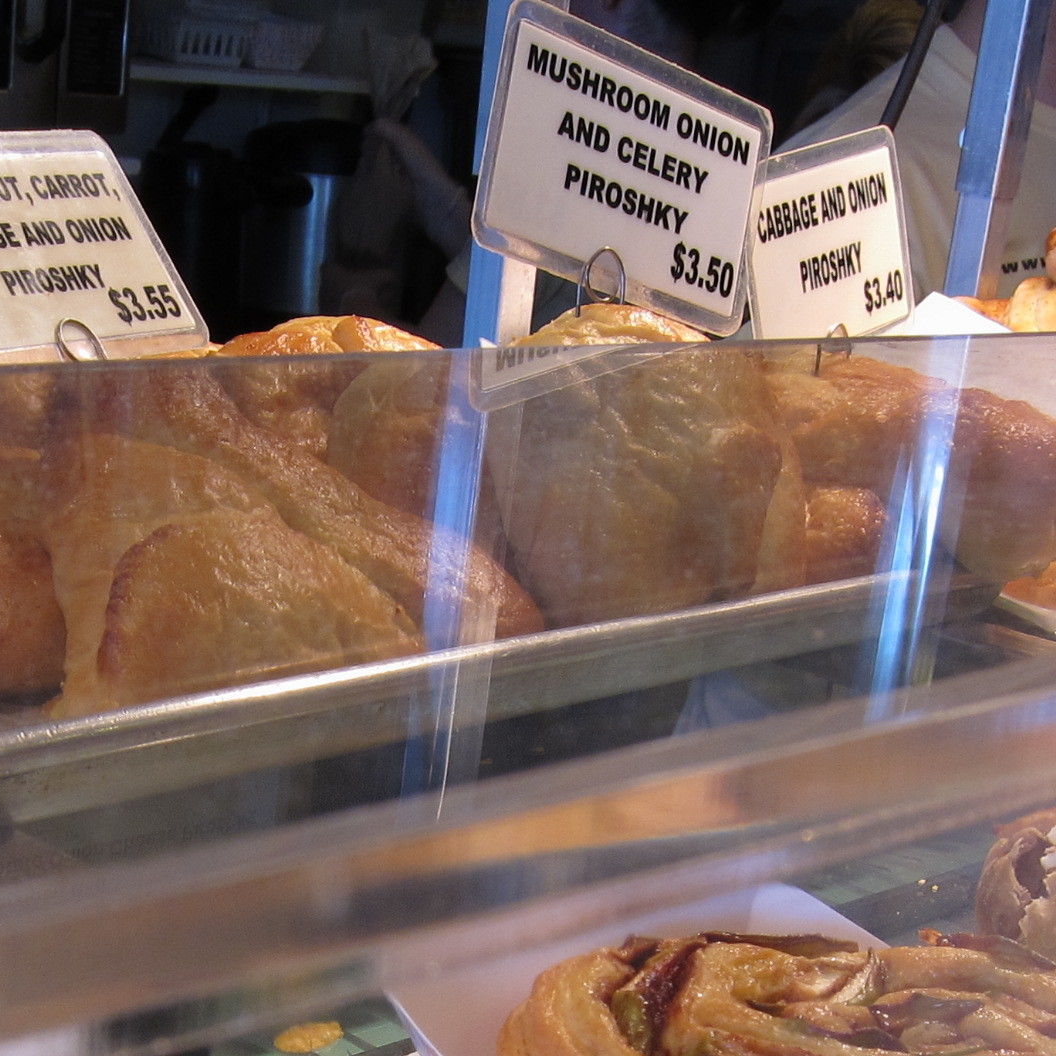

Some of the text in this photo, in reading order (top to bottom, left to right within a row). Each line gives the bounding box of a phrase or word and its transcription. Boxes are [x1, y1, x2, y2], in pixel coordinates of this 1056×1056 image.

[527, 44, 750, 165] MUSHROOM ONION
[557, 111, 709, 194] AND CELERY
[31, 172, 121, 201] CARROT,
[564, 163, 688, 235] PIROSHKY
[757, 172, 888, 244] CABBAGE AND ONION
[22, 220, 66, 247] AND
[67, 216, 132, 243] ONION
[0, 264, 106, 296] PIROSHKY
[670, 241, 735, 298] $3.50
[799, 241, 862, 293] PIROSHKY
[1001, 257, 1046, 274] ww
[108, 284, 181, 327] $3.55
[863, 269, 904, 316] $3.40
